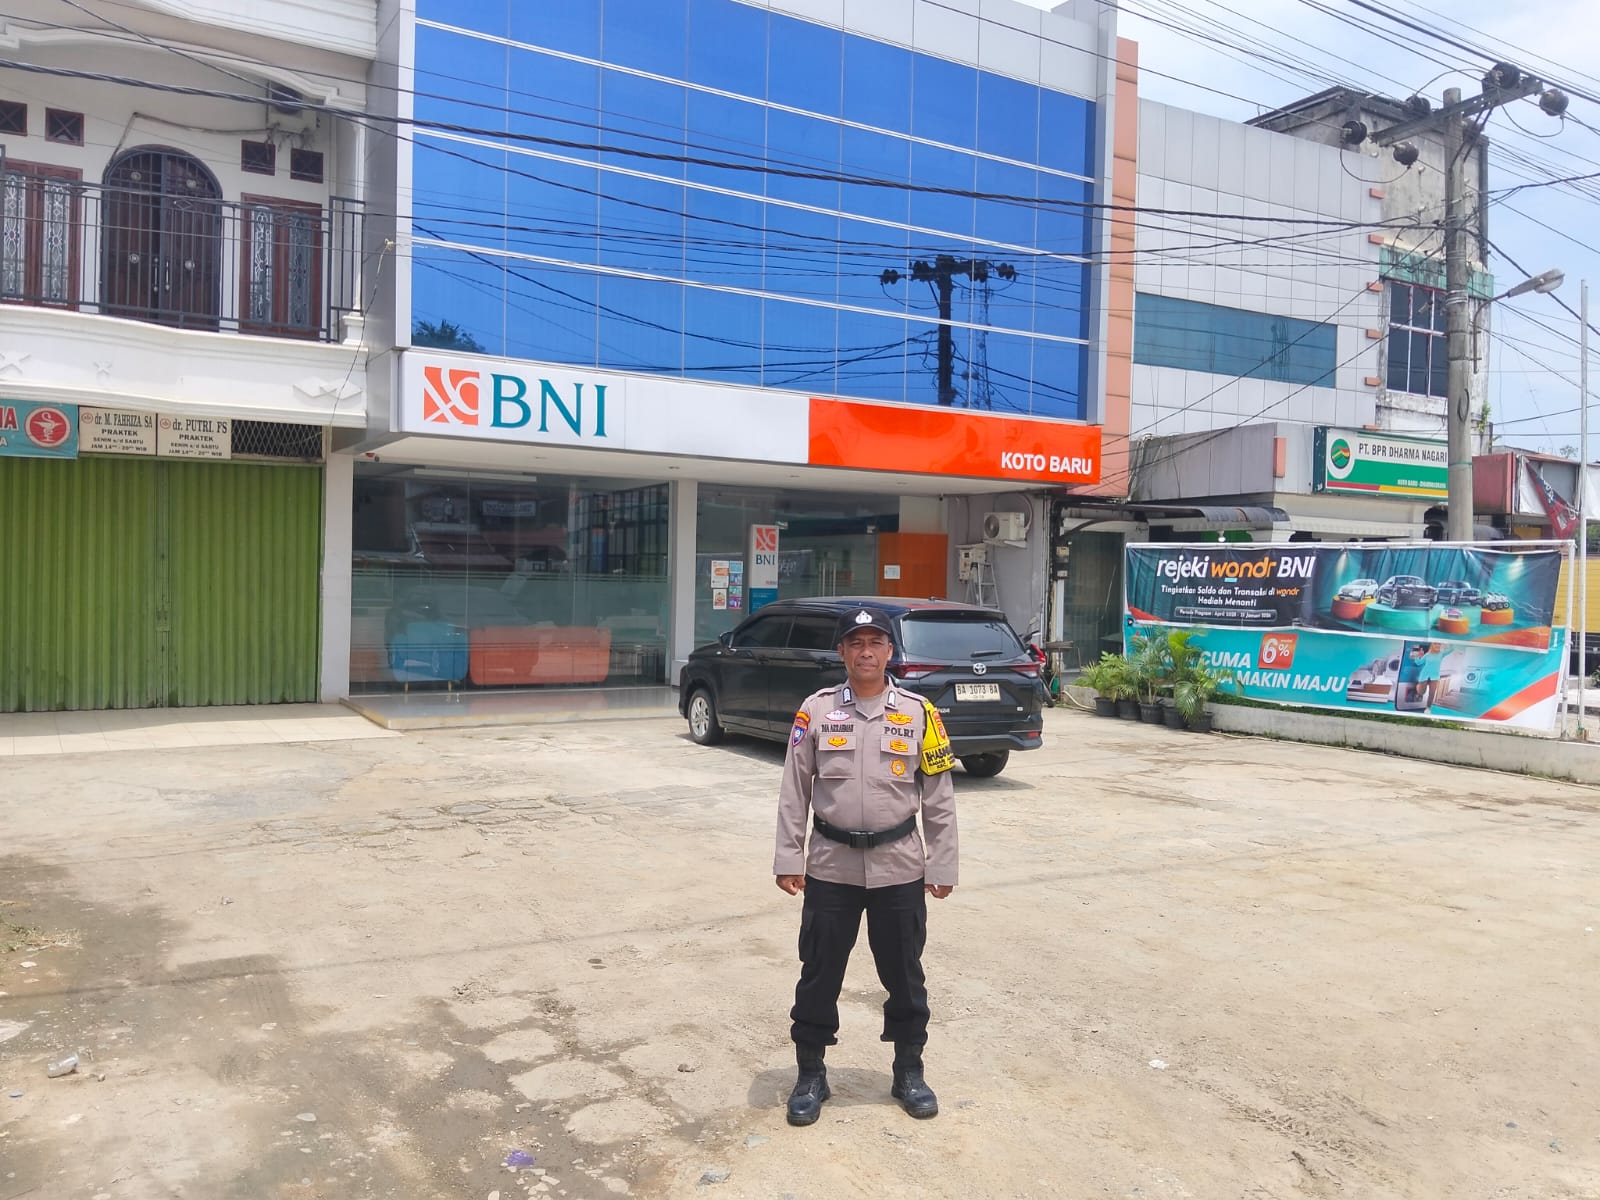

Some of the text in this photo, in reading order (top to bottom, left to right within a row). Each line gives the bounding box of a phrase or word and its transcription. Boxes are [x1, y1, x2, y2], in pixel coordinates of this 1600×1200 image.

[490, 373, 608, 437] BNI
[0, 406, 18, 431] A
[172, 418, 183, 431] dr.
[216, 421, 228, 434] FS
[101, 428, 138, 437] PRAKTEK
[179, 433, 214, 442] PRAKTEK
[1358, 443, 1447, 463] PT. BPR DHARMA NAGARI
[1001, 451, 1092, 475] KOTO BARU
[755, 554, 775, 565] BNI
[1156, 555, 1316, 583] rejeki wondr BNI
[1197, 585, 1216, 595] Saldo
[1217, 586, 1232, 595] dan
[1233, 586, 1267, 597] Transaksi
[1268, 587, 1275, 596] di
[1198, 596, 1257, 607] Hadiah Menanti
[1263, 638, 1290, 664] 6%
[1201, 651, 1251, 668] CUMA
[957, 685, 966, 694] BA
[1236, 670, 1290, 689] MAKIN
[1292, 675, 1346, 693] MAJU
[884, 726, 914, 738] POLRI
